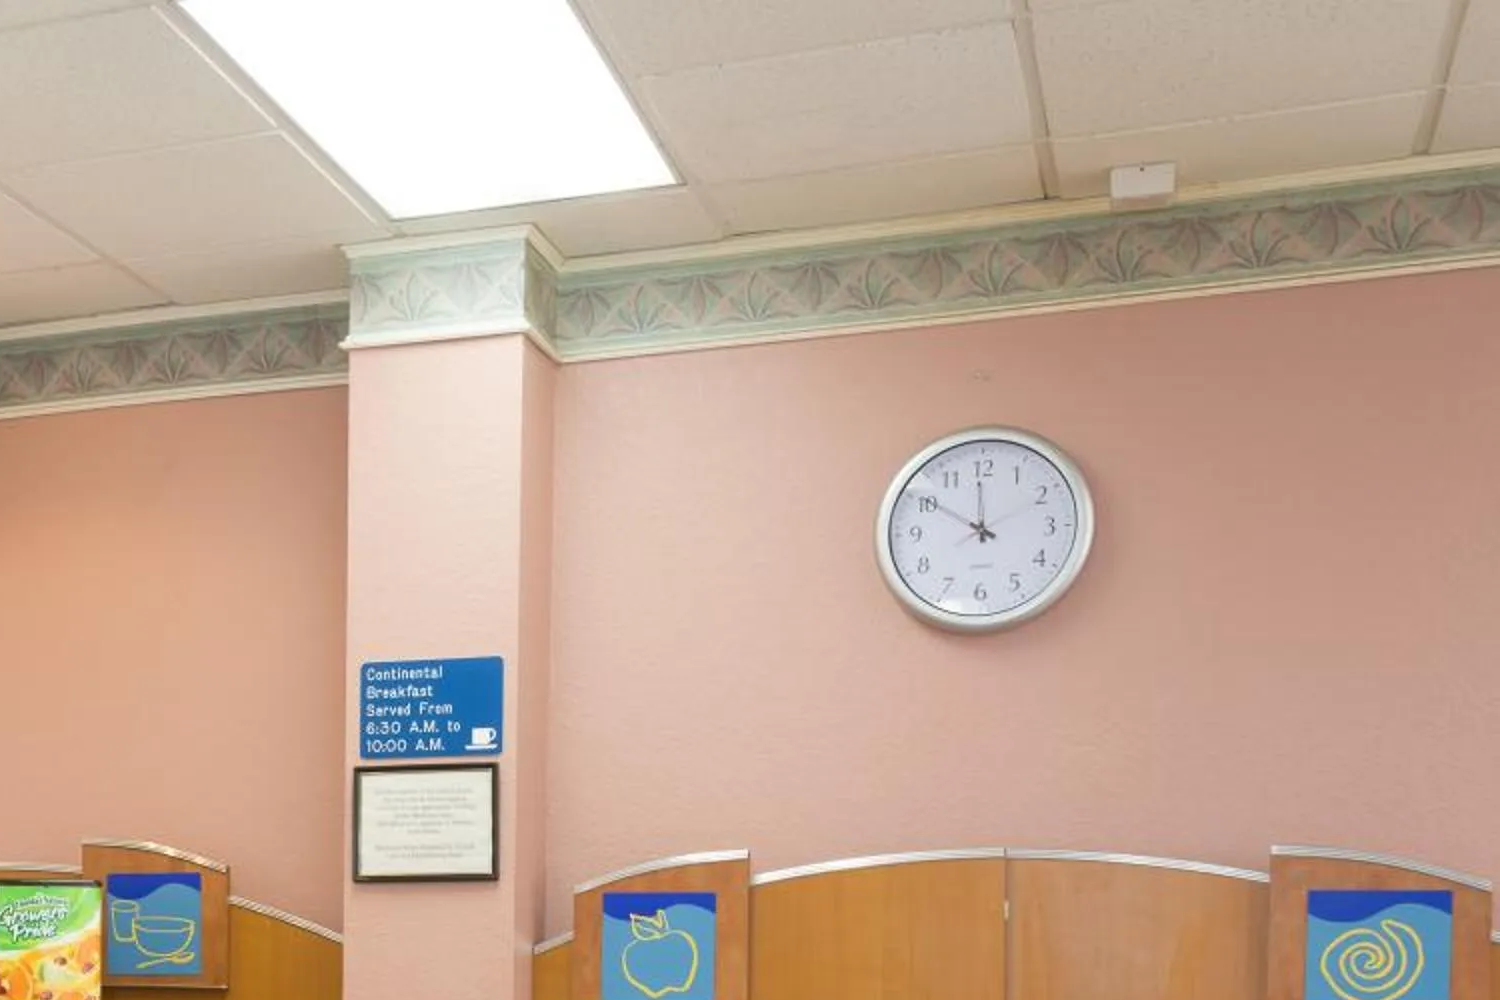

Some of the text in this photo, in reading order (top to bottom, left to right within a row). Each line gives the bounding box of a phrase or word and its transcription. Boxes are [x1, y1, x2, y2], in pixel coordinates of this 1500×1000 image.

[974, 459, 994, 477] 12
[1013, 465, 1021, 485] 1
[943, 471, 959, 489] 11
[1034, 485, 1049, 505] 2
[918, 495, 938, 514] 10
[909, 526, 923, 543] 9
[1044, 516, 1056, 537] 3
[917, 556, 930, 574] 8
[1032, 549, 1046, 568] 4
[942, 577, 955, 595] 7
[973, 582, 988, 601] 6
[1008, 573, 1021, 592] 5
[366, 665, 443, 681] Continental
[366, 684, 433, 699] Breakfast
[366, 701, 453, 717] Served From
[366, 720, 461, 735] 6:30 A.M. to
[366, 738, 445, 753] 10:00 A.M.
